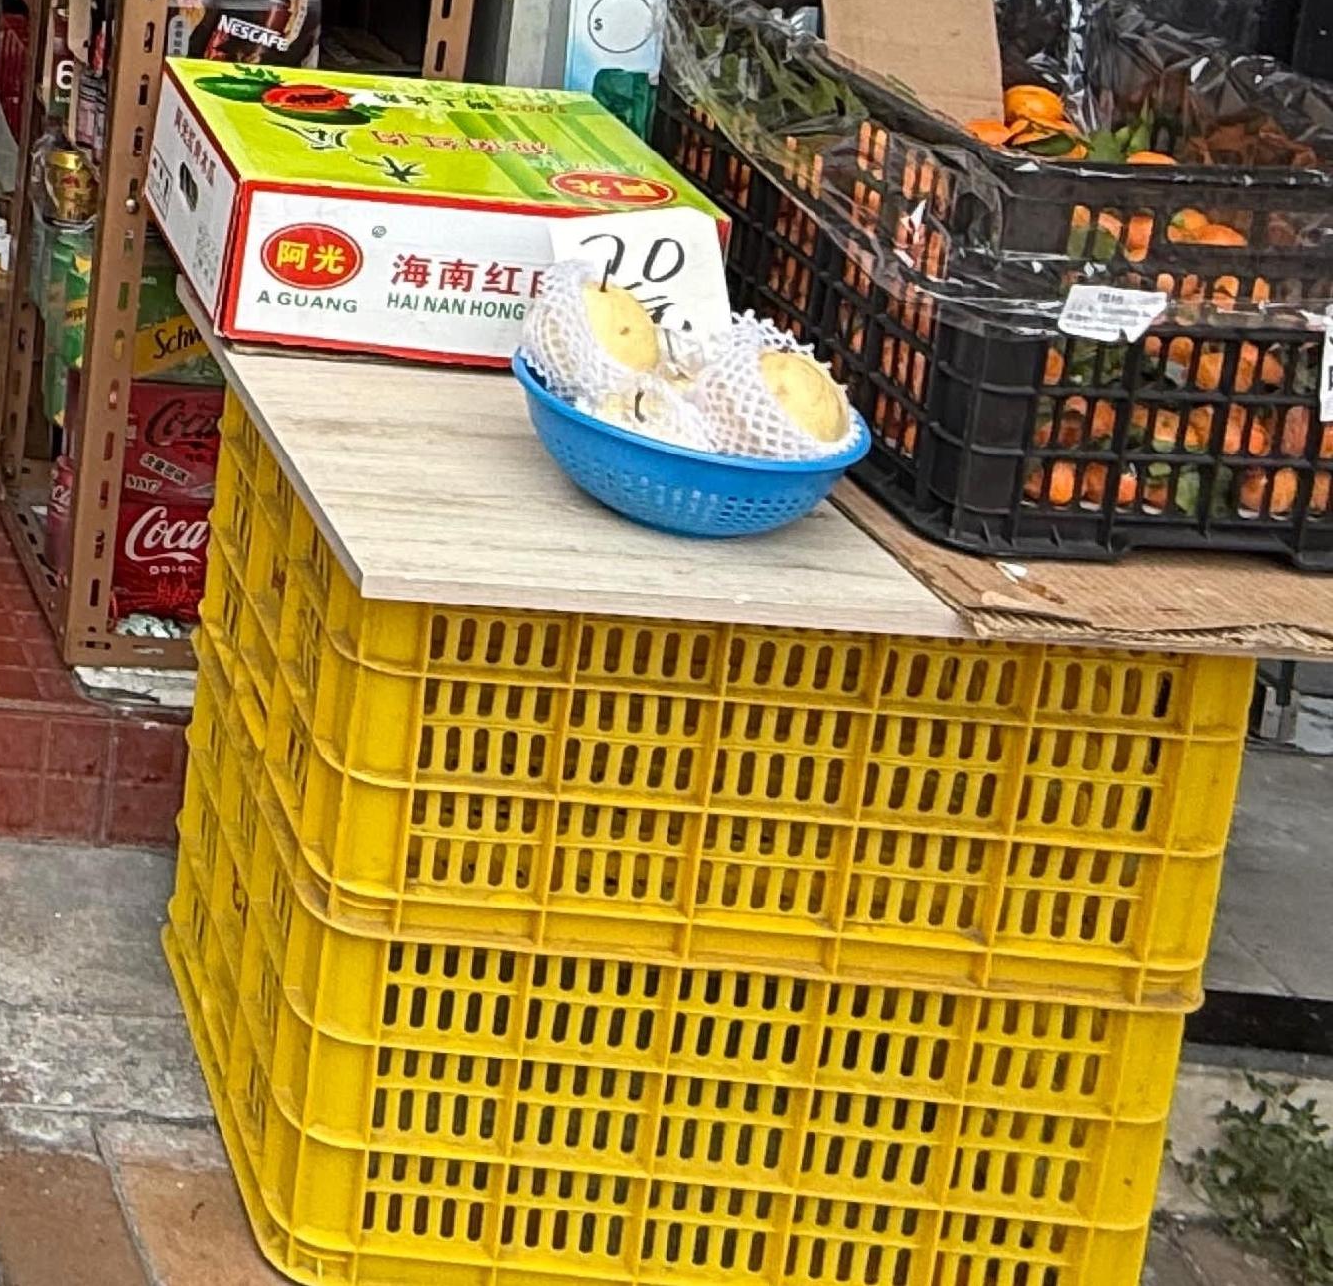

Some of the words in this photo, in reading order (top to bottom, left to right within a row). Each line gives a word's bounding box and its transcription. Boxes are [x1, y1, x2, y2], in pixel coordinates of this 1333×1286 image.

[274, 238, 347, 275] 阿光
[256, 289, 272, 306] A
[276, 291, 359, 314] GUANG
[386, 291, 422, 312] HAI
[424, 295, 466, 317] NAN
[469, 298, 525, 321] HONG
[124, 505, 210, 564] Coca
